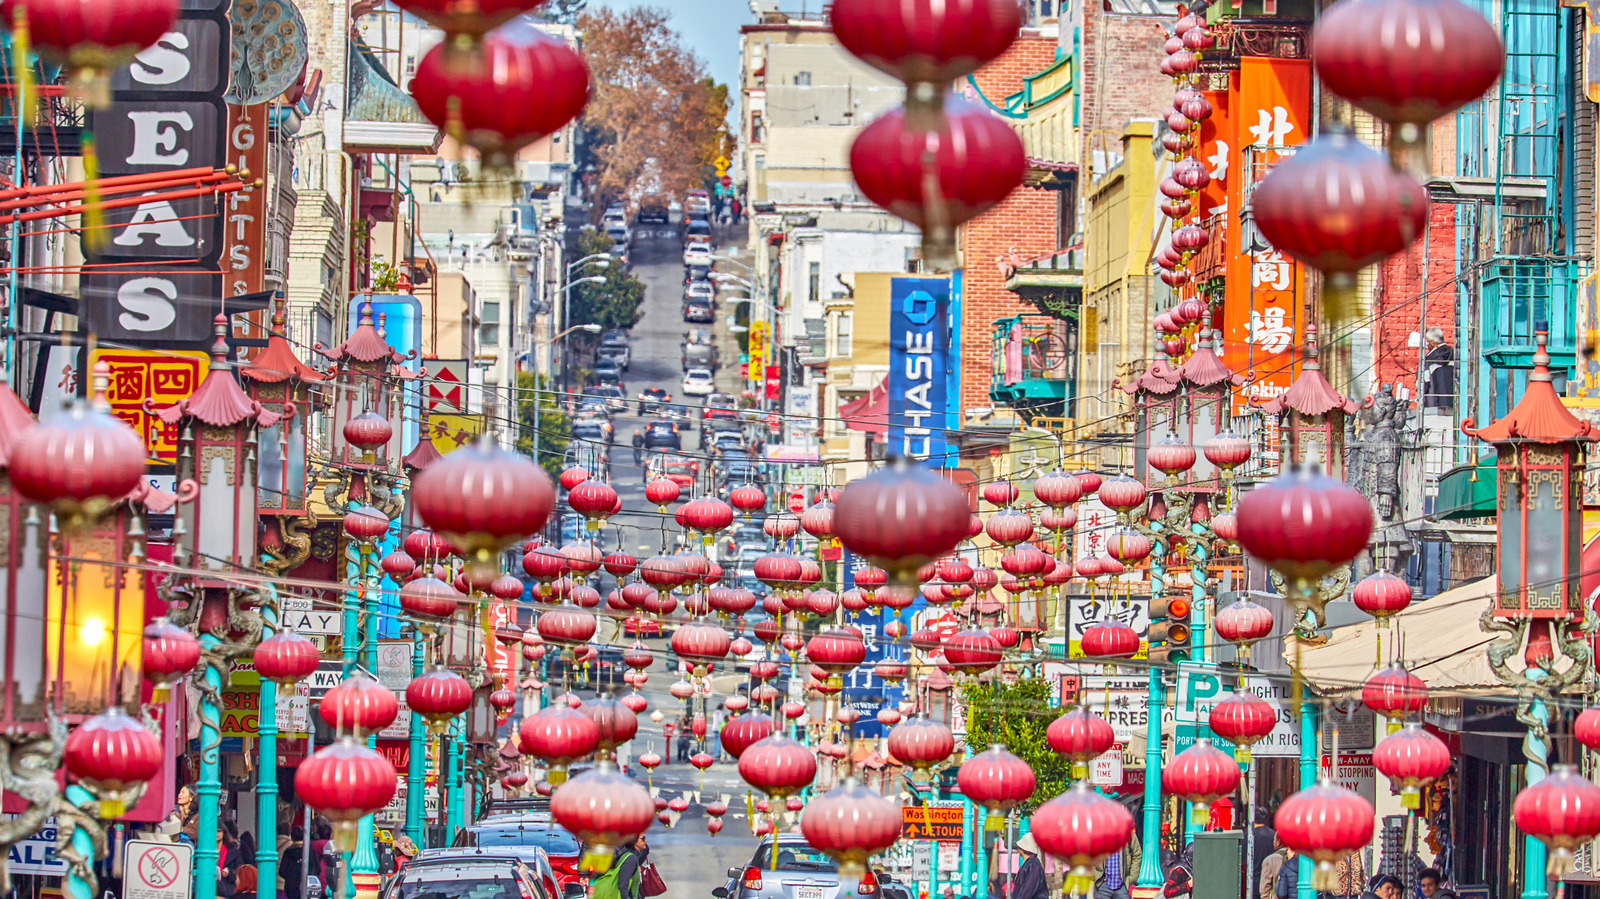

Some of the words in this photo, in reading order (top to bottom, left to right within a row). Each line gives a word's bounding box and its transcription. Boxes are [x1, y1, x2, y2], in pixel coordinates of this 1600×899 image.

[903, 330, 933, 462] CHASE
[1087, 512, 1102, 549] 北京
[281, 613, 332, 630] LAY
[315, 673, 343, 686] WAY
[1252, 686, 1279, 699] IGHT
[1279, 734, 1302, 746] RIG
[1327, 756, 1370, 765] TW-AWAY
[1096, 770, 1112, 778] TIME
[1339, 767, 1374, 778] STOPPING
[921, 825, 964, 837] DETOUR
[8, 844, 63, 866] ALE
